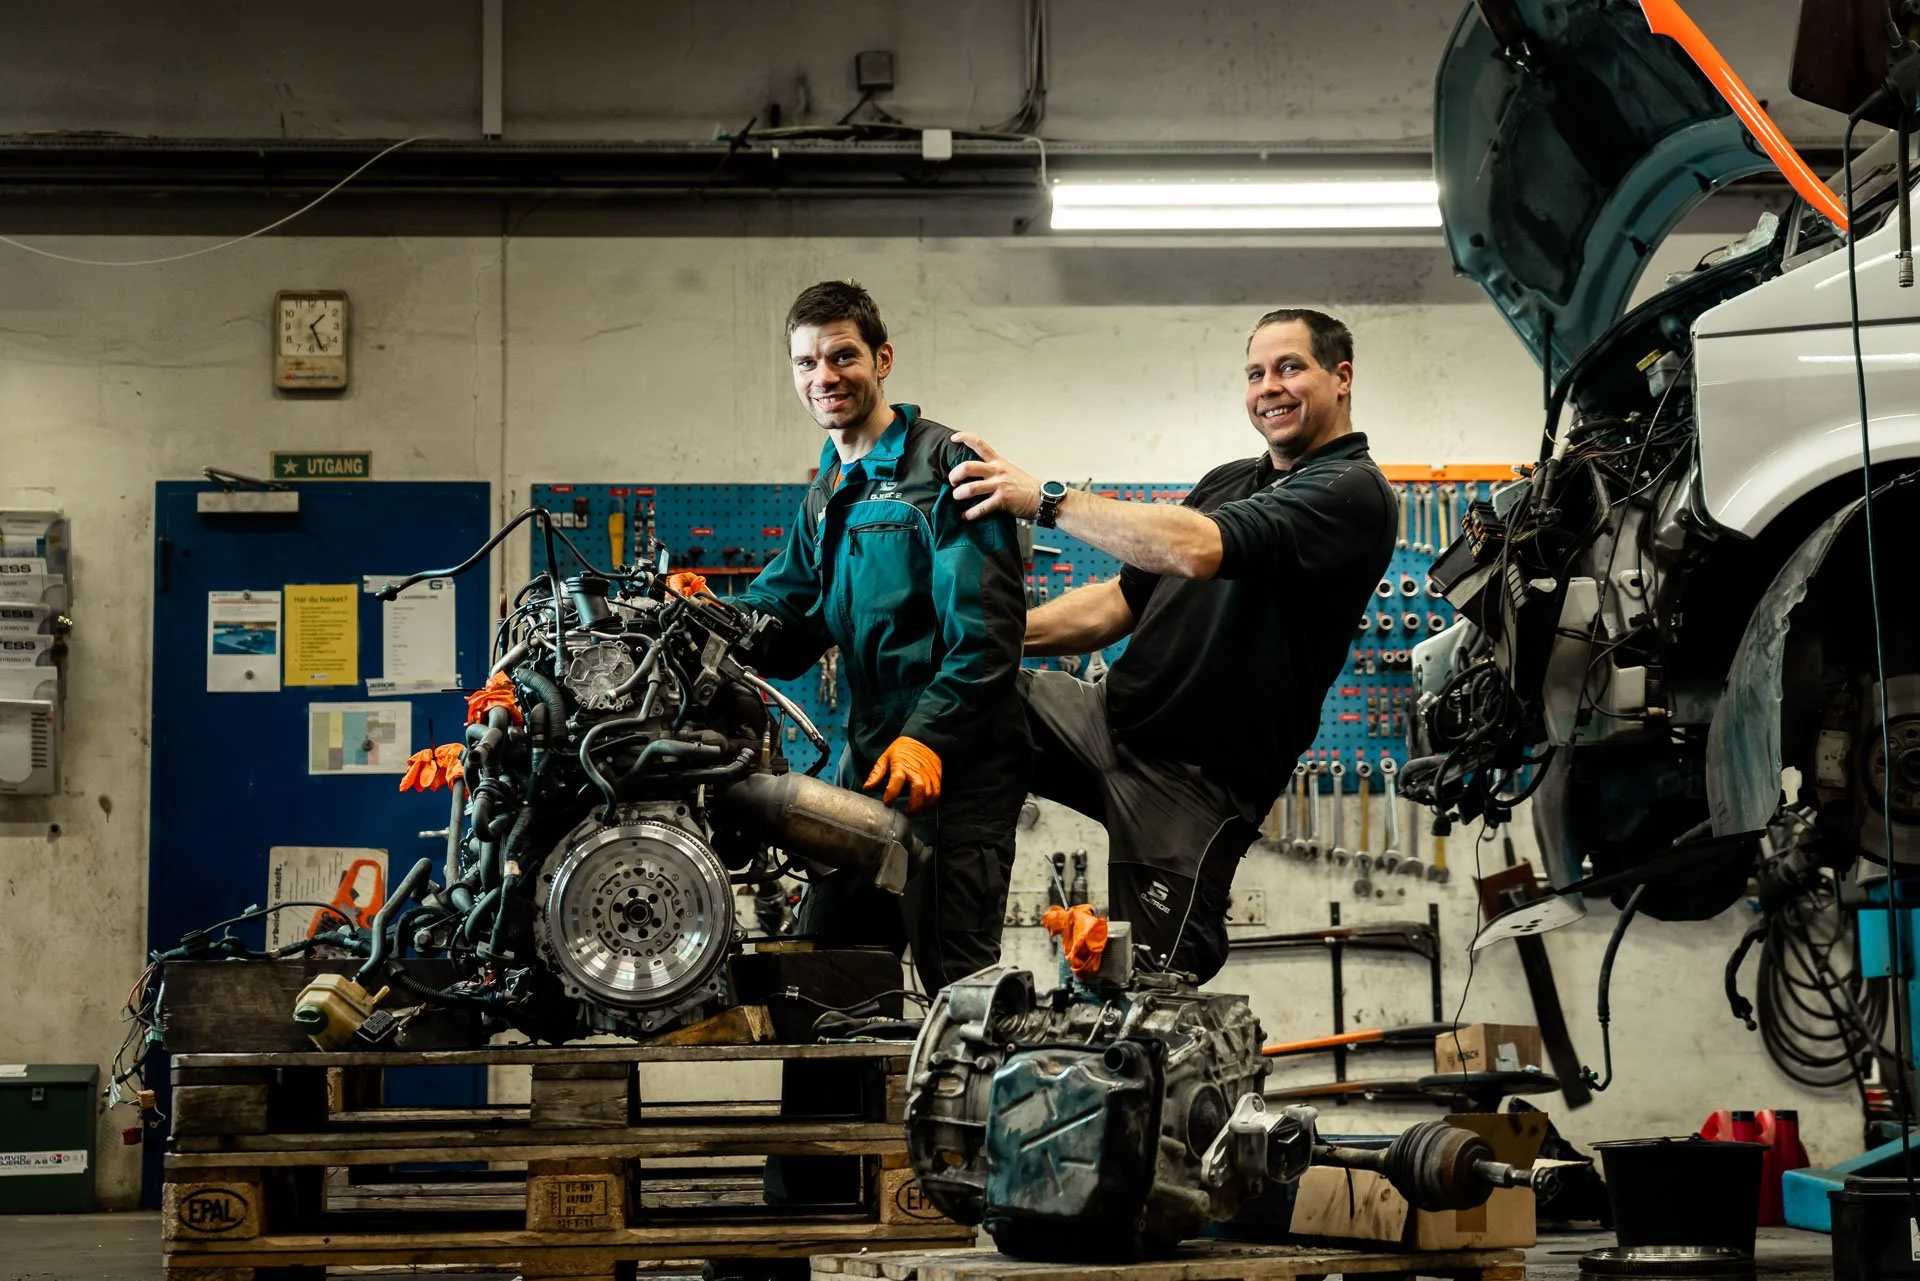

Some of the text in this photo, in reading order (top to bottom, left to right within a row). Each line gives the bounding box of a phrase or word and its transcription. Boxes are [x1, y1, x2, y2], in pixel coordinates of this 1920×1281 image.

[285, 309, 295, 318] 10
[332, 308, 338, 317] 2
[285, 322, 291, 331] 9
[333, 322, 340, 331] 3
[286, 335, 292, 344] 8
[331, 335, 338, 344] 4
[296, 343, 302, 353] 7
[308, 344, 315, 354] 6
[307, 457, 363, 475] UTGANG
[188, 1198, 237, 1223] EPAL
